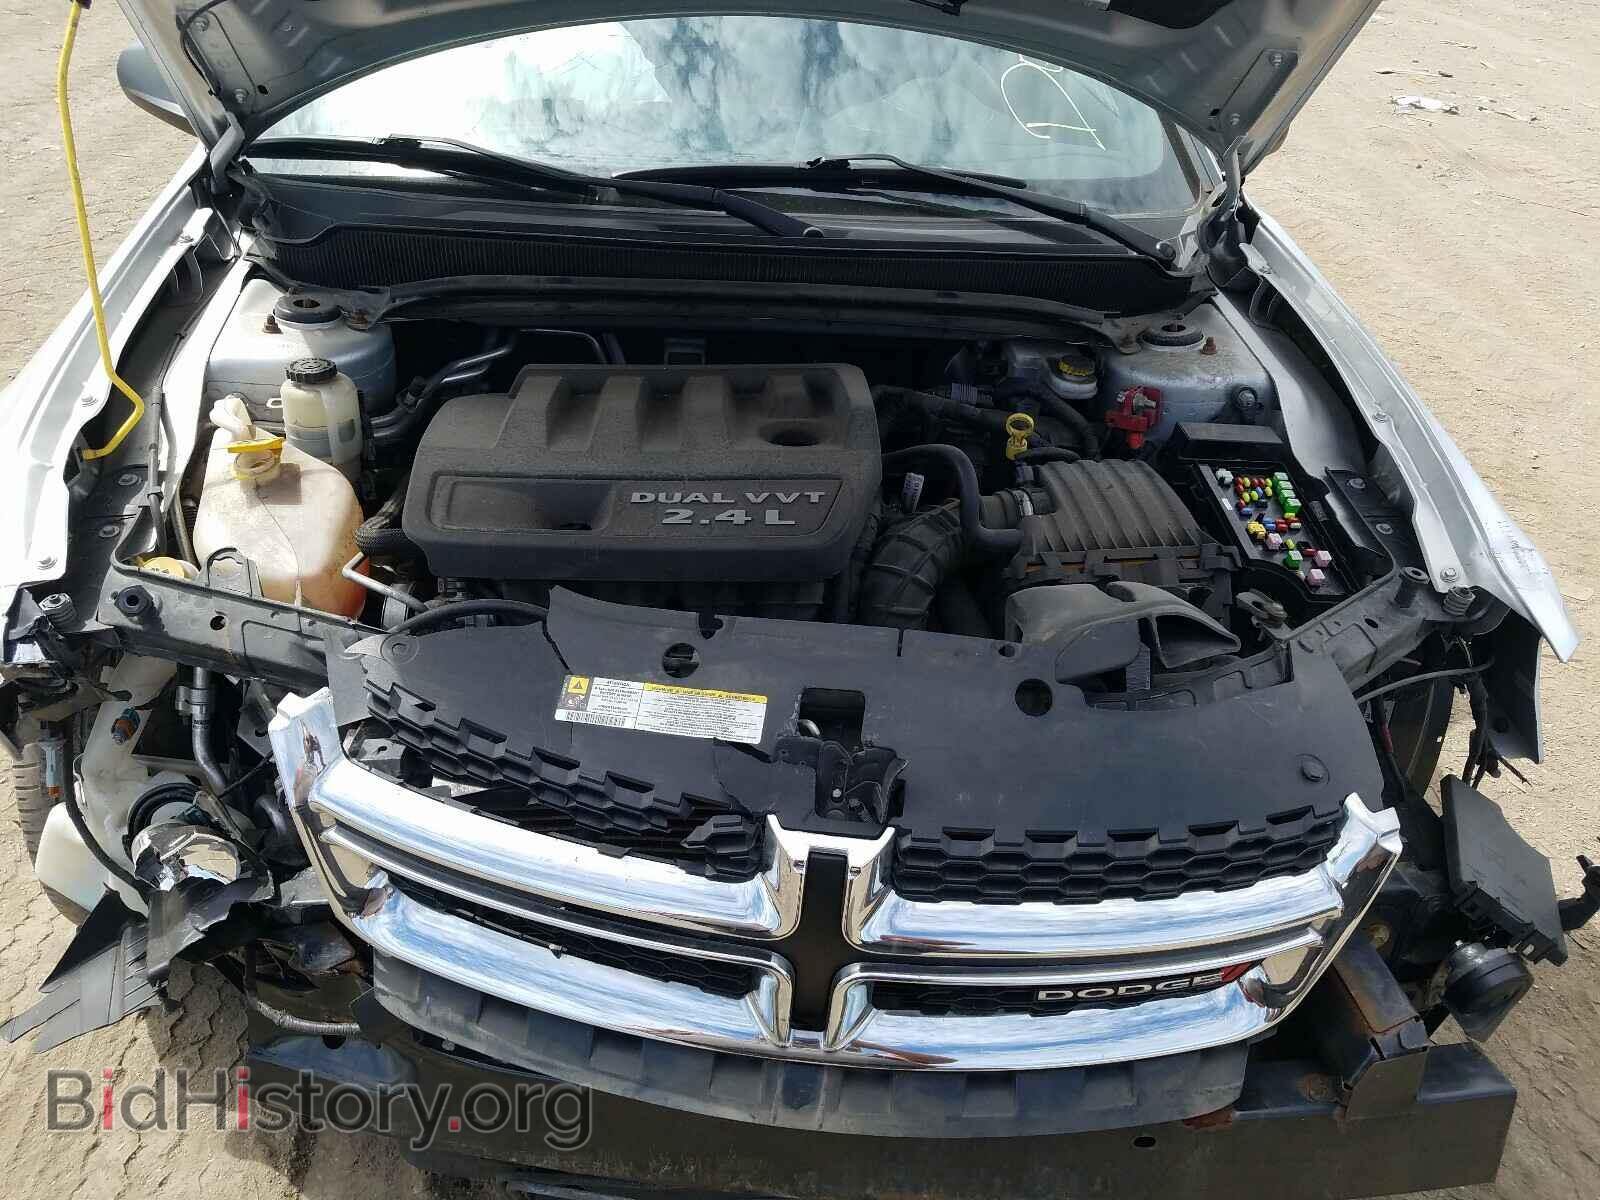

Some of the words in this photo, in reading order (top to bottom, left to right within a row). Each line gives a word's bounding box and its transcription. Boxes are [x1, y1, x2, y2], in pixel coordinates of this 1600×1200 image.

[631, 492, 735, 503] DUAL
[744, 491, 825, 503] VVT
[1037, 973, 1224, 1000] DODGE
